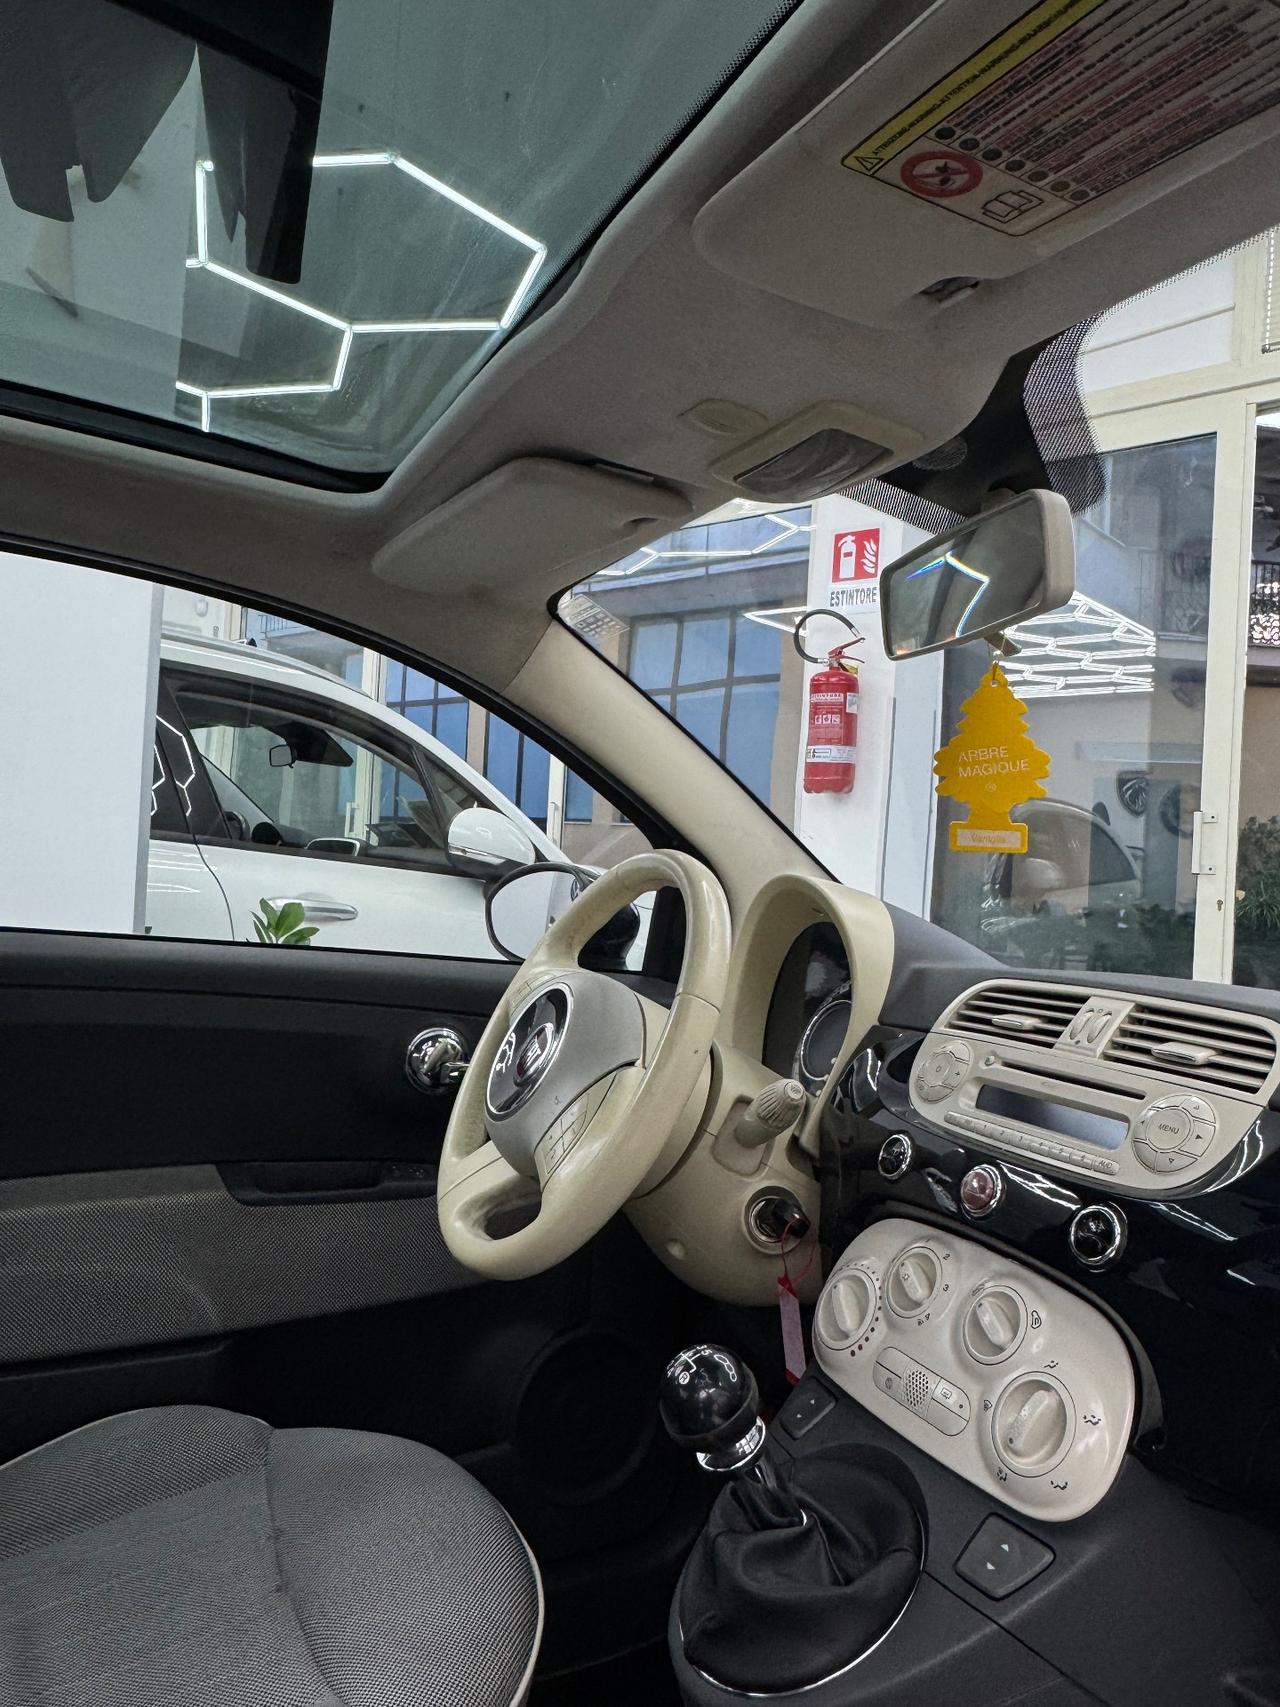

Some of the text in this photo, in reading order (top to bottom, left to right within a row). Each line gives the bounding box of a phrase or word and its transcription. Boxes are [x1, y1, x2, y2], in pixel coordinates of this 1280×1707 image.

[829, 587, 878, 607] ESTINTORE
[958, 746, 1009, 762] ARBRE
[958, 759, 1031, 777] MAGIQUE
[1158, 1123, 1180, 1135] MENU
[943, 1284, 950, 1292] 3
